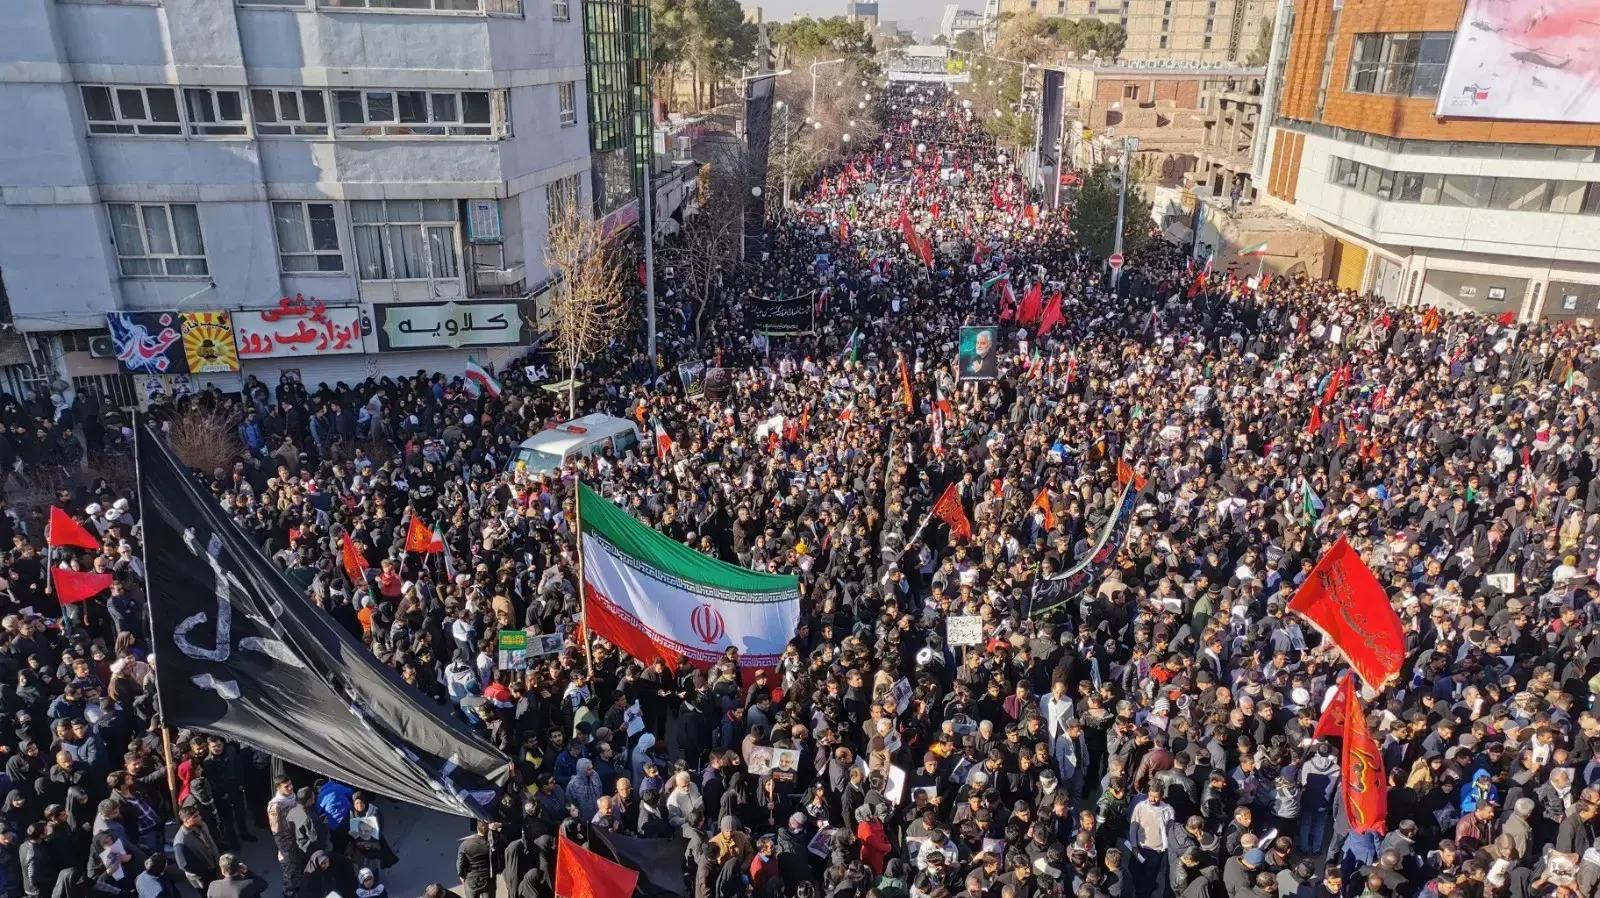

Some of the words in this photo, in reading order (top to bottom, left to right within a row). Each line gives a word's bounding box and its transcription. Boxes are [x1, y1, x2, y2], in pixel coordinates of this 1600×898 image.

[261, 292, 327, 324] پزشکی
[274, 320, 318, 351] طب
[315, 319, 360, 351] ابزار
[398, 312, 509, 337] کلاویه
[118, 313, 181, 371] غبار
[238, 327, 273, 354] روز
